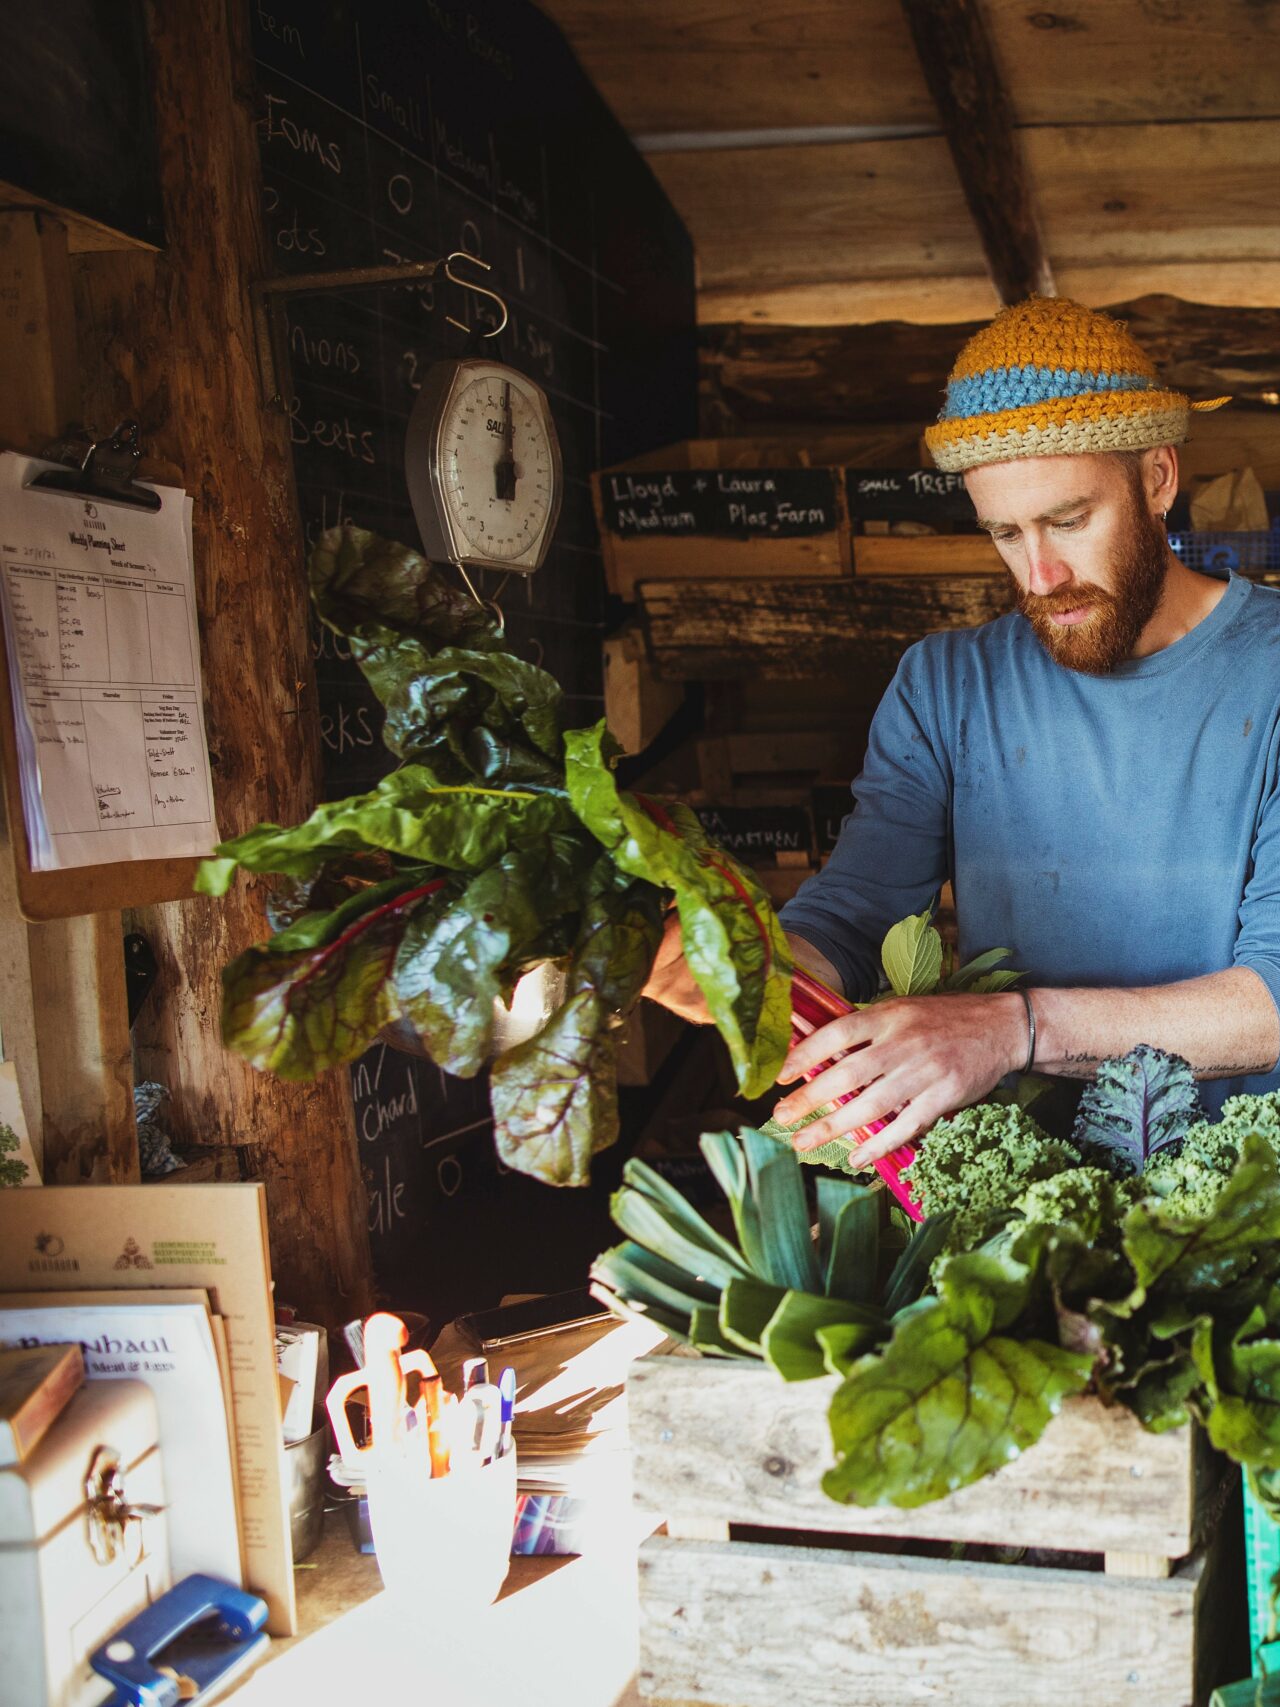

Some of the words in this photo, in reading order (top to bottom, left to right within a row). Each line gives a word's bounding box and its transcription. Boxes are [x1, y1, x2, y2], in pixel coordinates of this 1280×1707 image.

[367, 73, 424, 141] Small
[610, 474, 680, 508] Lloyd
[692, 477, 708, 493] +
[717, 473, 777, 493] Laura
[618, 506, 697, 531] Medium
[776, 502, 825, 525] Farm
[362, 1066, 418, 1142] Chard
